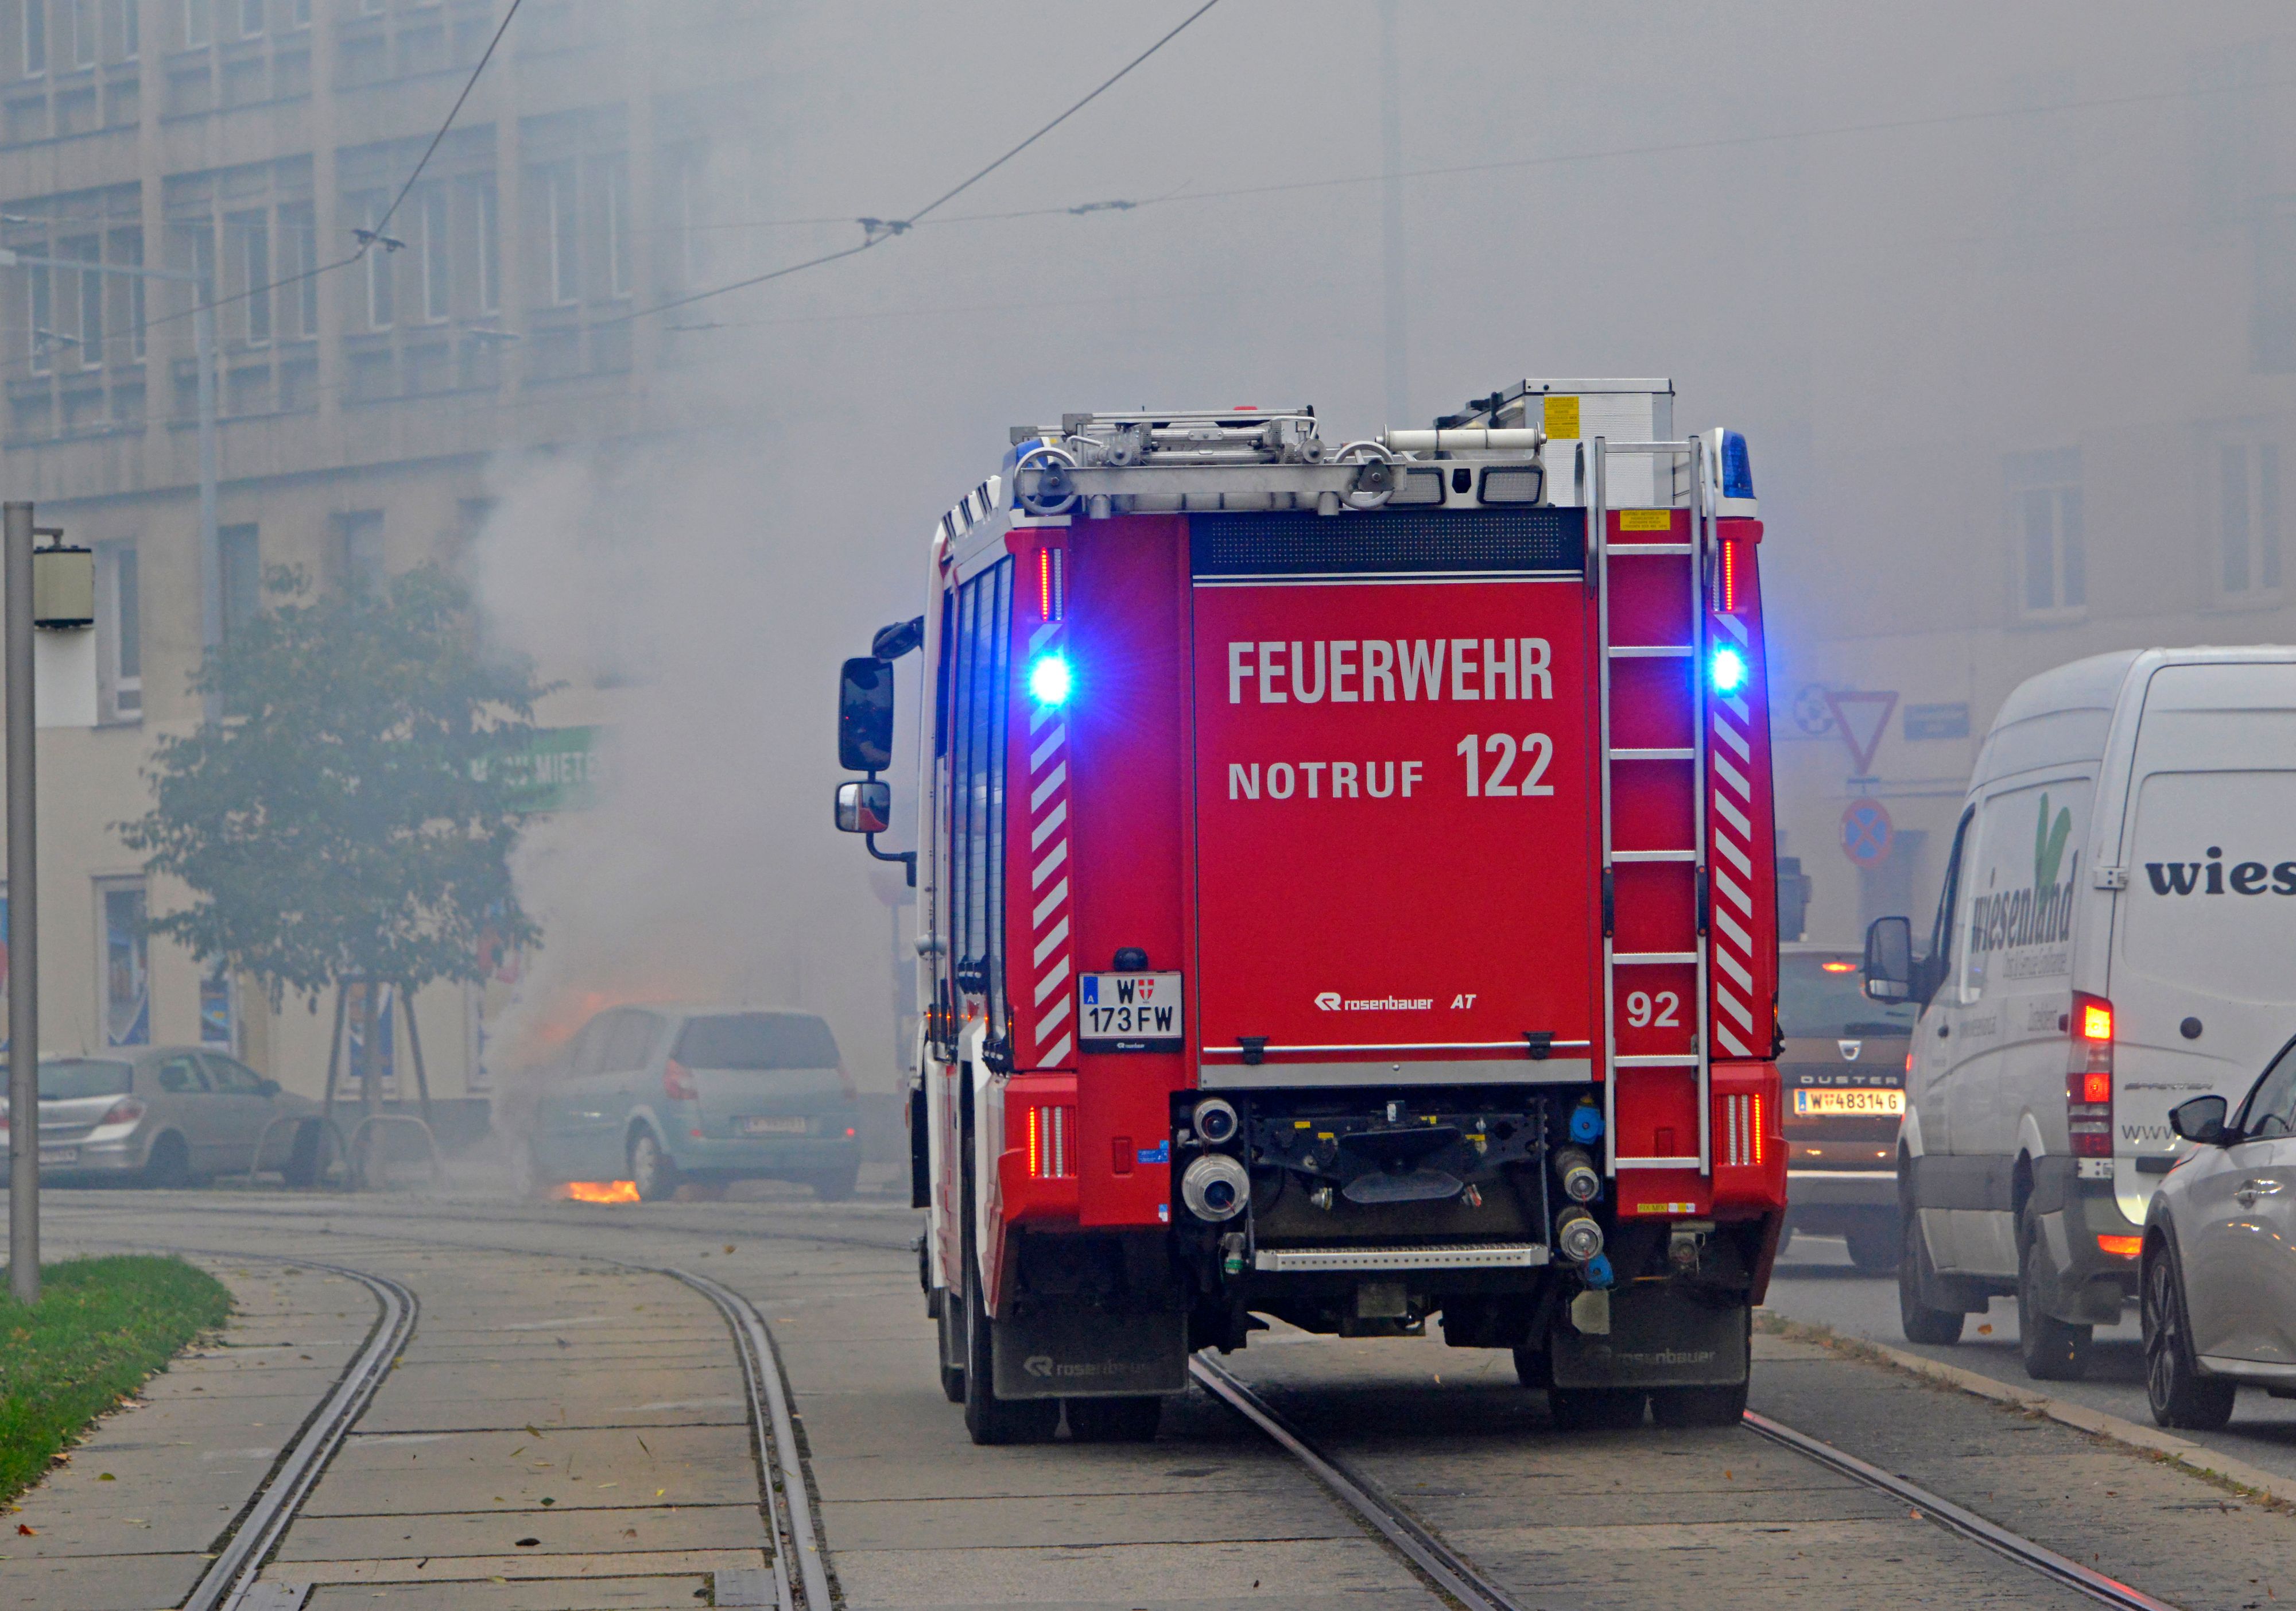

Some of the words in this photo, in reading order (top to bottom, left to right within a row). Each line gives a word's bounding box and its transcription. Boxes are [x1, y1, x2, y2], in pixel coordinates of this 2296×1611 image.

[1228, 637, 1553, 704] FEUERWEHR
[1229, 761, 1423, 800] NOTRUF
[1456, 733, 1554, 797] 122
[2145, 846, 2296, 896] wies
[1971, 849, 2080, 954] wiesenland
[1116, 979, 1135, 1004] W
[1344, 995, 1433, 1010] rosenbauer
[1450, 994, 1477, 1009] AT
[1626, 991, 1680, 1028] 92
[1800, 1075, 1898, 1085] DUSTER
[1810, 1093, 1822, 1109] W
